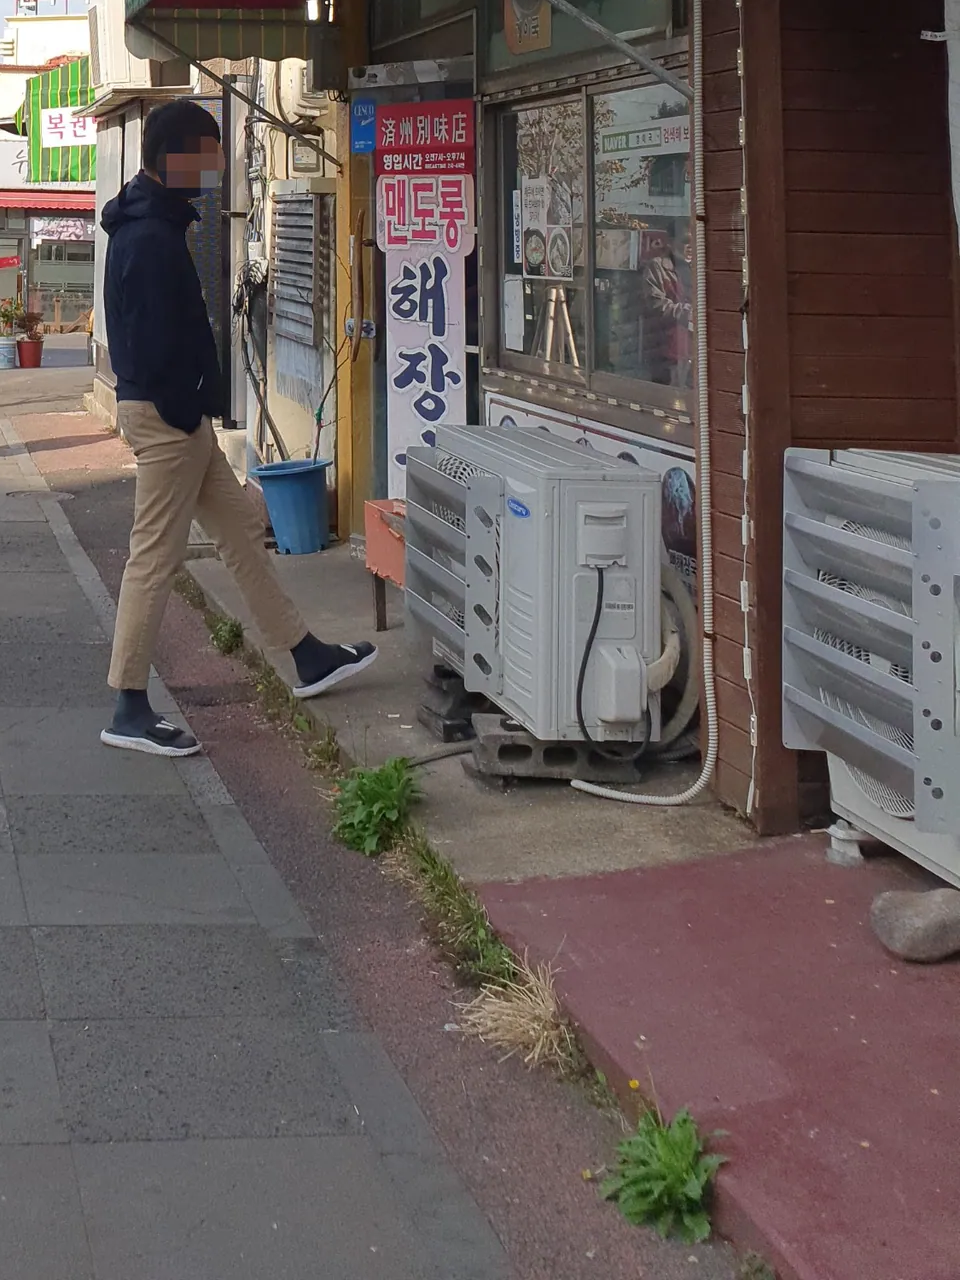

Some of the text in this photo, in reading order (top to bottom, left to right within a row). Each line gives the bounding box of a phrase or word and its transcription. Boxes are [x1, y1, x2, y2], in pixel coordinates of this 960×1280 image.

[47, 113, 97, 140] 복권
[382, 112, 467, 147] 済州別味店
[604, 135, 627, 151] NAVER
[383, 153, 422, 170] 영업시간
[384, 178, 466, 249] 맨도롱
[390, 256, 462, 466] 해장
